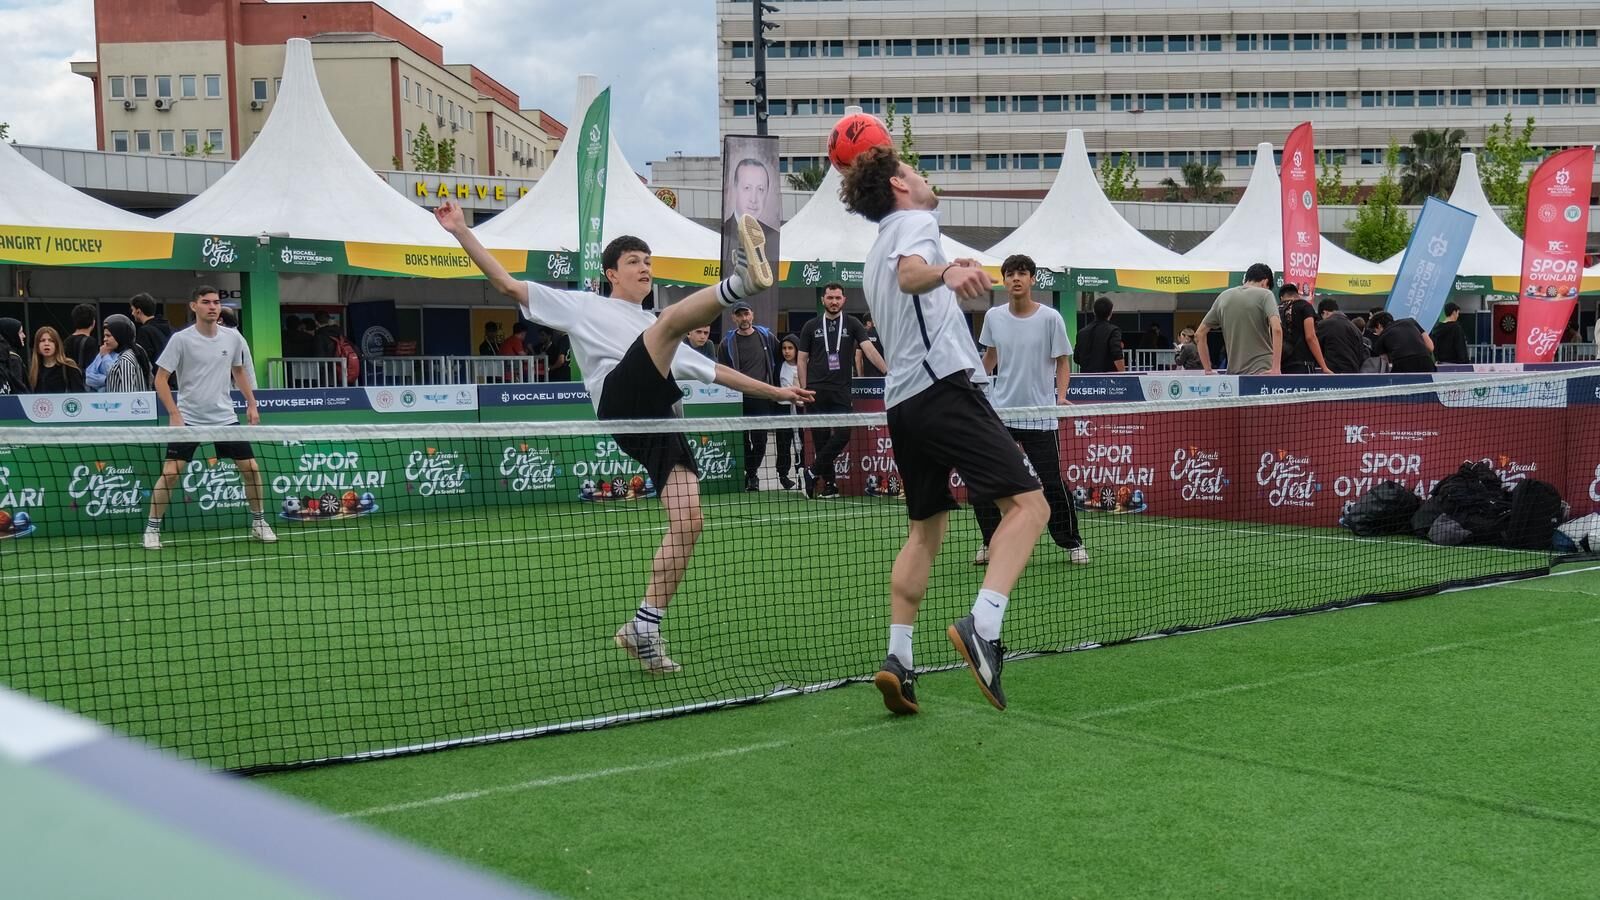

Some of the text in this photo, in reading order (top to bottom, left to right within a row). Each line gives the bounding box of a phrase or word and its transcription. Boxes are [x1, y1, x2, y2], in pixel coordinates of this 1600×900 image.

[415, 181, 506, 201] KAHVE
[55, 237, 102, 253] HOCKEY
[405, 254, 429, 266] BOKS
[1290, 252, 1318, 269] SPOR
[1530, 259, 1578, 273] SPOR
[704, 263, 721, 277] BİLE
[1529, 272, 1577, 282] OYUNLARI
[1155, 276, 1171, 285] MASA
[1360, 279, 1371, 287] GOLF
[557, 391, 592, 400] BÜYÜK
[298, 451, 359, 471] SPOR
[1086, 444, 1132, 463] SPOR
[1360, 452, 1421, 475] SPOR
[272, 471, 387, 493] OYUNLARI
[1067, 464, 1154, 486] OYUNLARI
